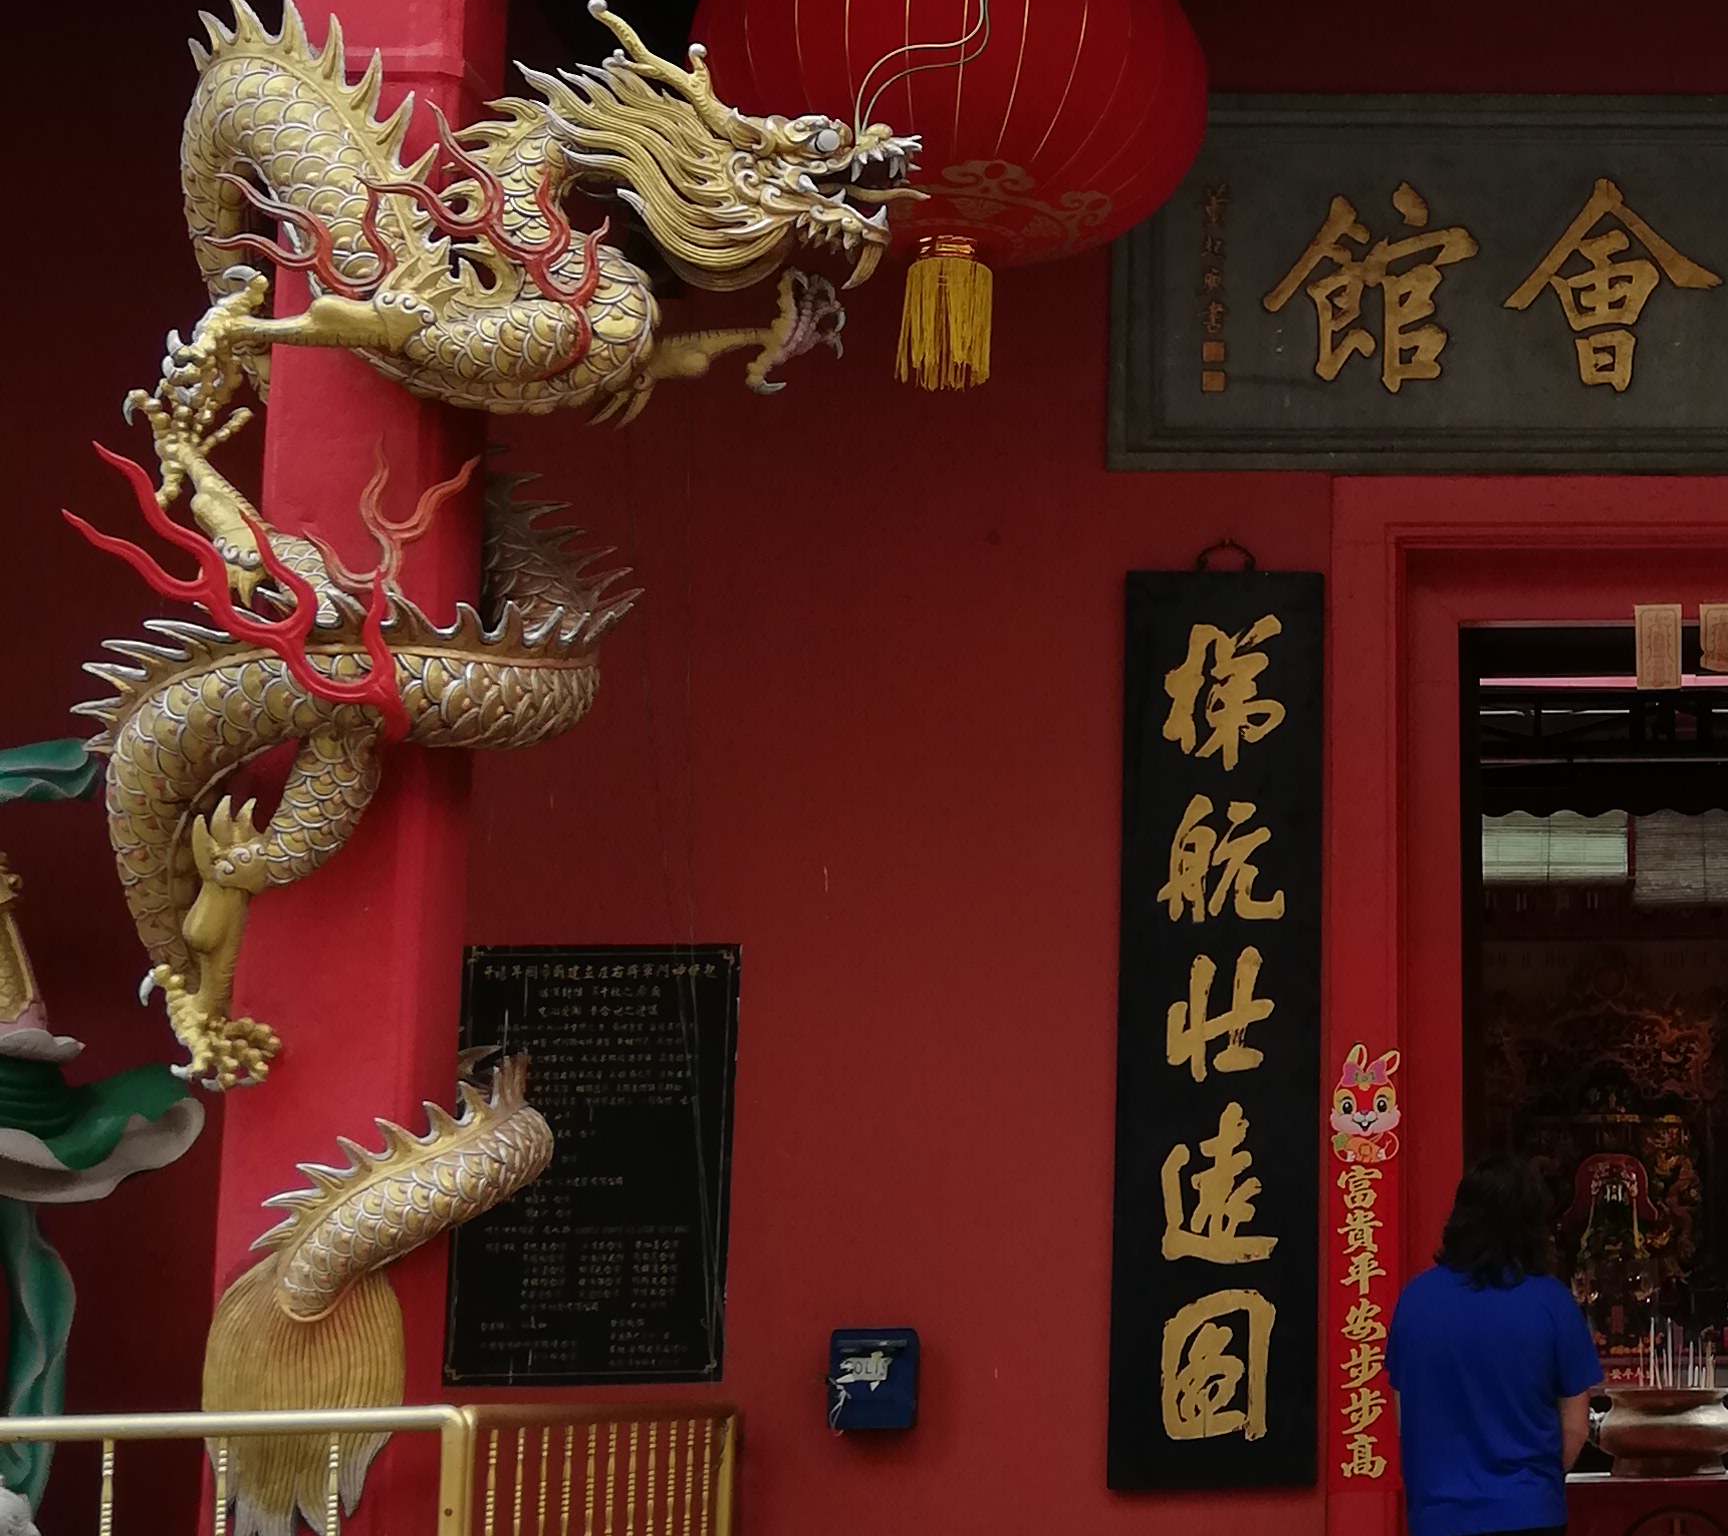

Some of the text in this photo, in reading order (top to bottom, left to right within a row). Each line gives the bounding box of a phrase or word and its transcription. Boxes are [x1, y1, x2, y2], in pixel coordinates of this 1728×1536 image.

[1336, 1163, 1388, 1479] 富貴平安步步高
